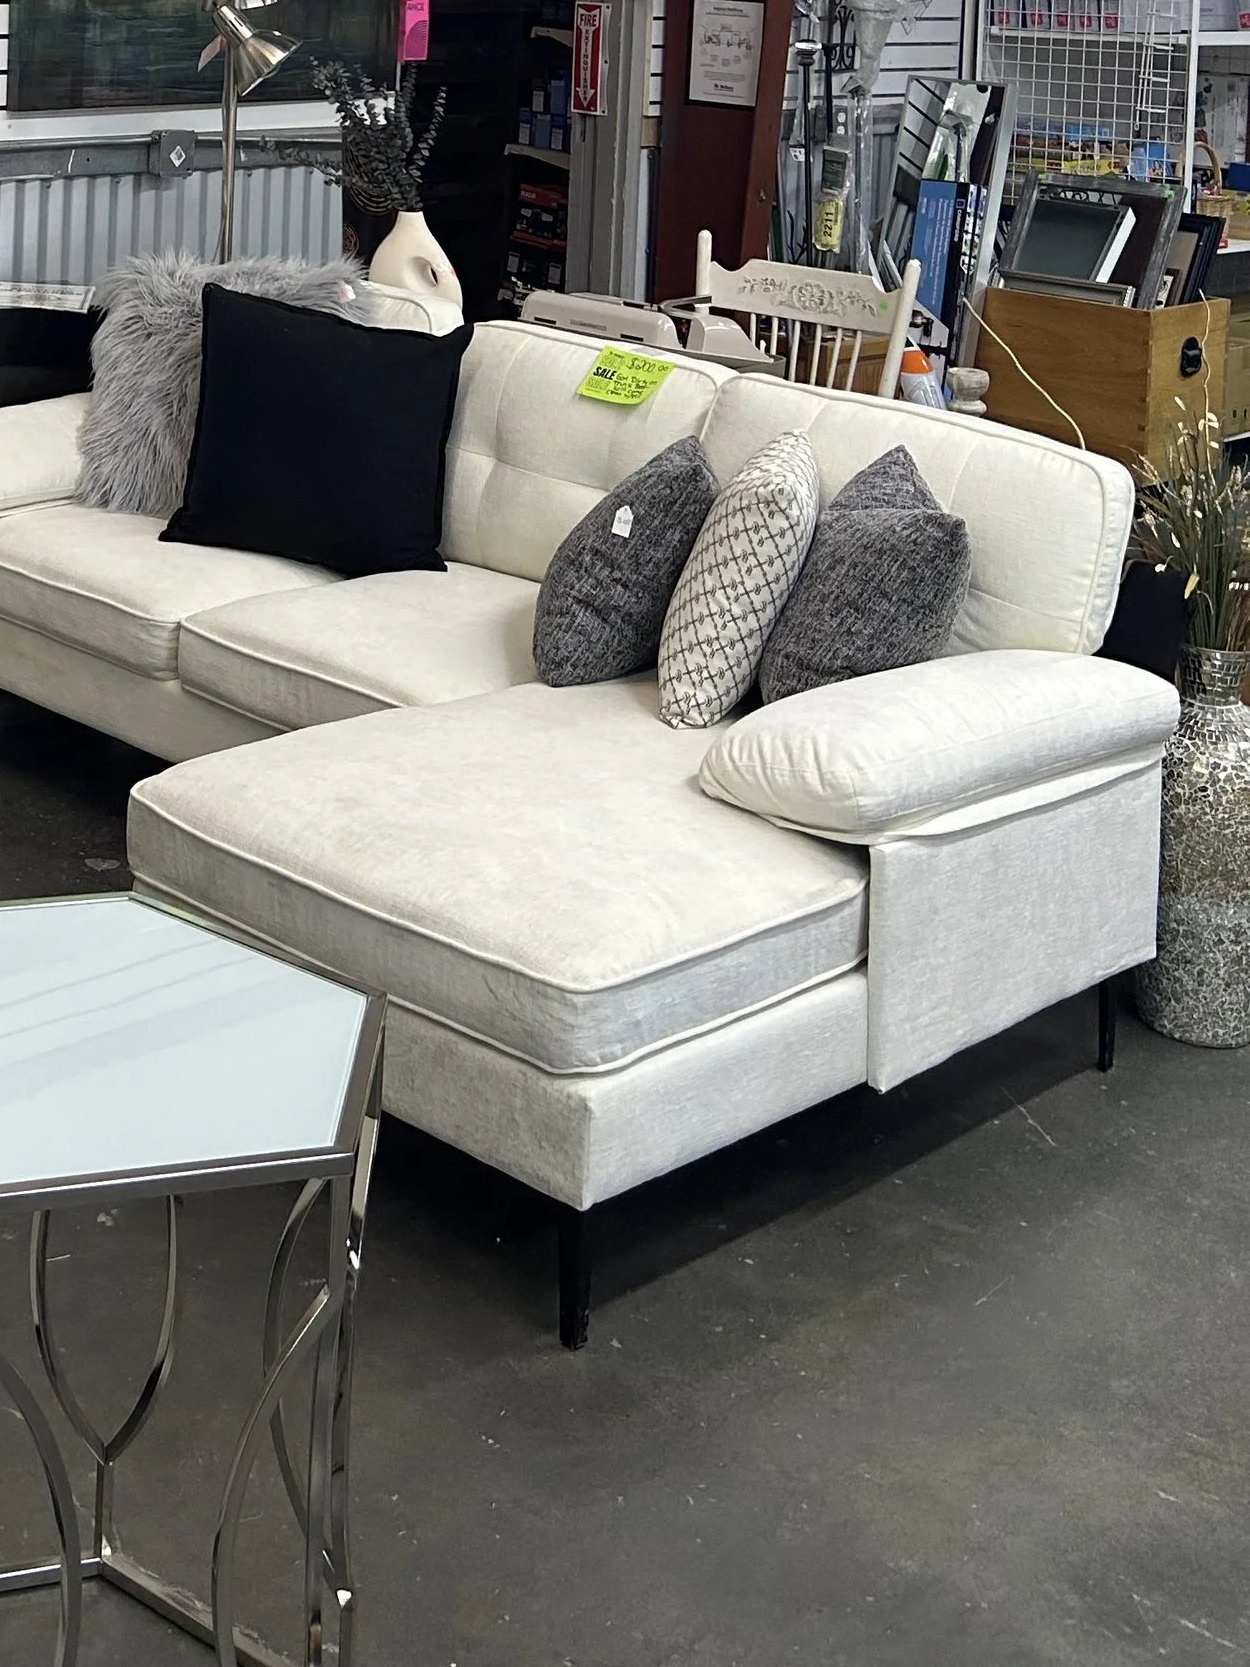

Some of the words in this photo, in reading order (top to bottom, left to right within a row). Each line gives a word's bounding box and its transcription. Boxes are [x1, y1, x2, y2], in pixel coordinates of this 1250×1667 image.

[579, 13, 598, 28] FIRE
[582, 29, 590, 103] EXTINGUISHER
[822, 211, 834, 238] 2211
[593, 366, 618, 381] SALE
